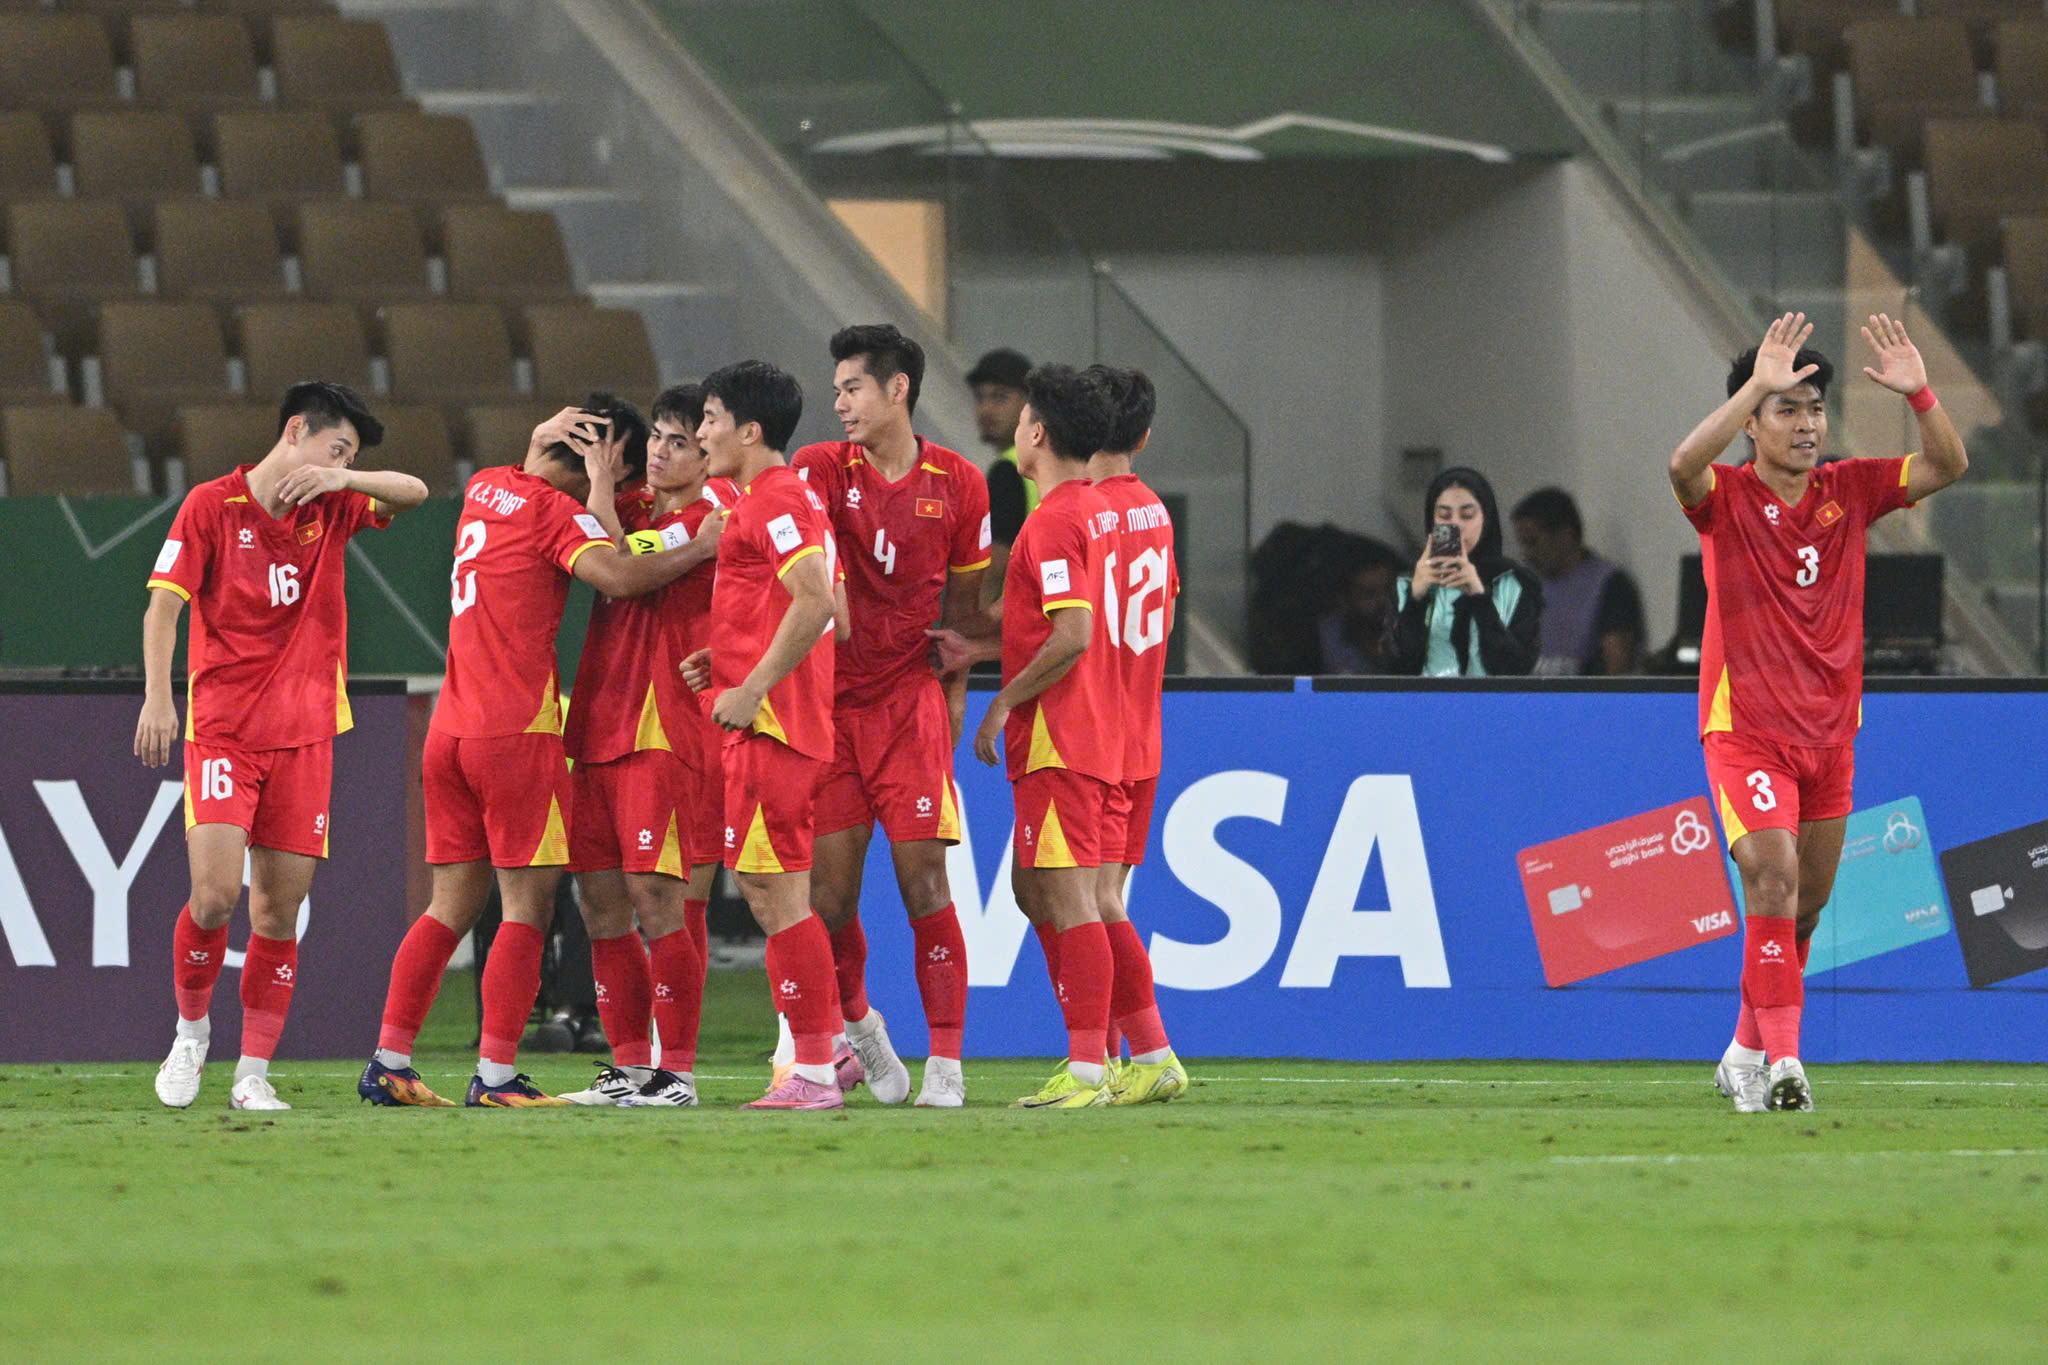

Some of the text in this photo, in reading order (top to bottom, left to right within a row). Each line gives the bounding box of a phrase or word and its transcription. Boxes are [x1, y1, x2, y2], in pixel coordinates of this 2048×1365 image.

[451, 519, 487, 617] 2
[874, 528, 896, 575] 4
[1796, 545, 1819, 588] 3
[269, 562, 300, 608] 16
[201, 757, 233, 802] 16
[1746, 769, 1777, 813] 3
[1609, 844, 1665, 868] alrajhi bank
[946, 770, 1452, 991] VSA
[1690, 910, 1733, 934] VISA
